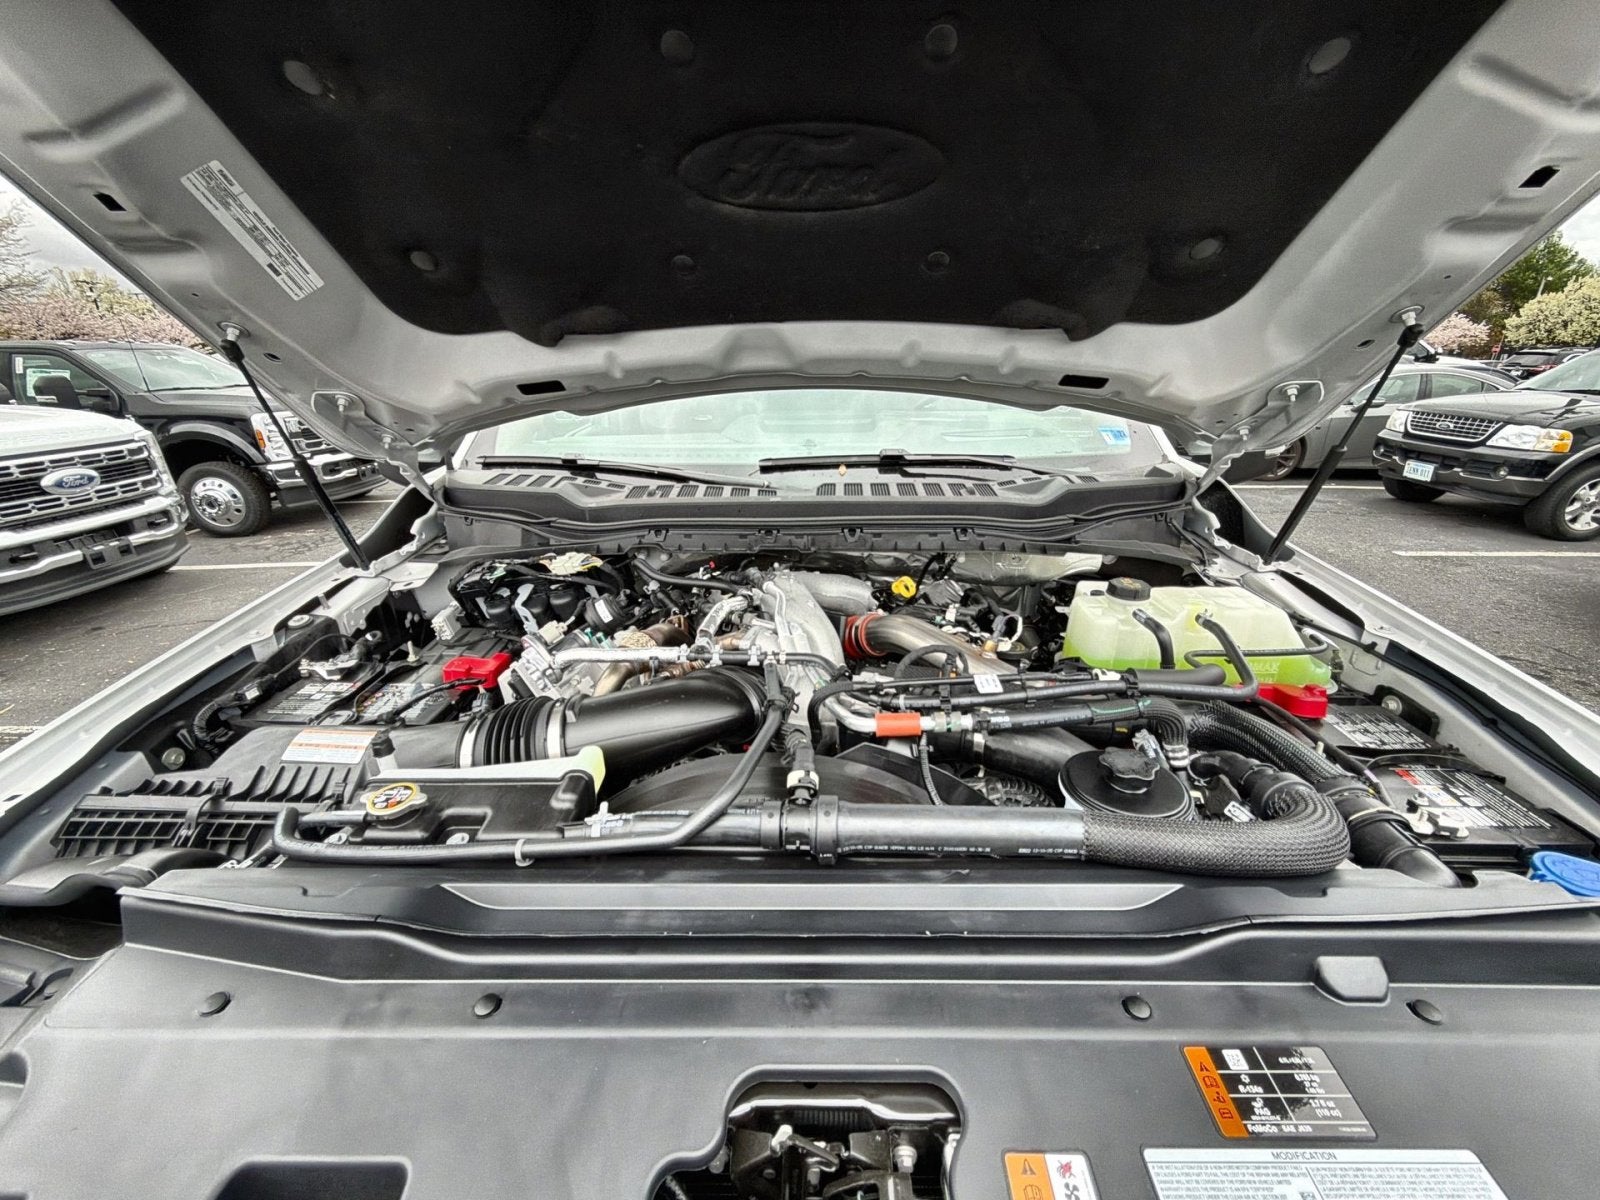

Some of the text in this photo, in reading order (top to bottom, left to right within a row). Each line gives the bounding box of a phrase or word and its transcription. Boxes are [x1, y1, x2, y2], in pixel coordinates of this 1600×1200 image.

[62, 474, 90, 489] Ford
[1246, 1123, 1279, 1134] FoMoCo
[1271, 1151, 1338, 1161] MODIFICATION
